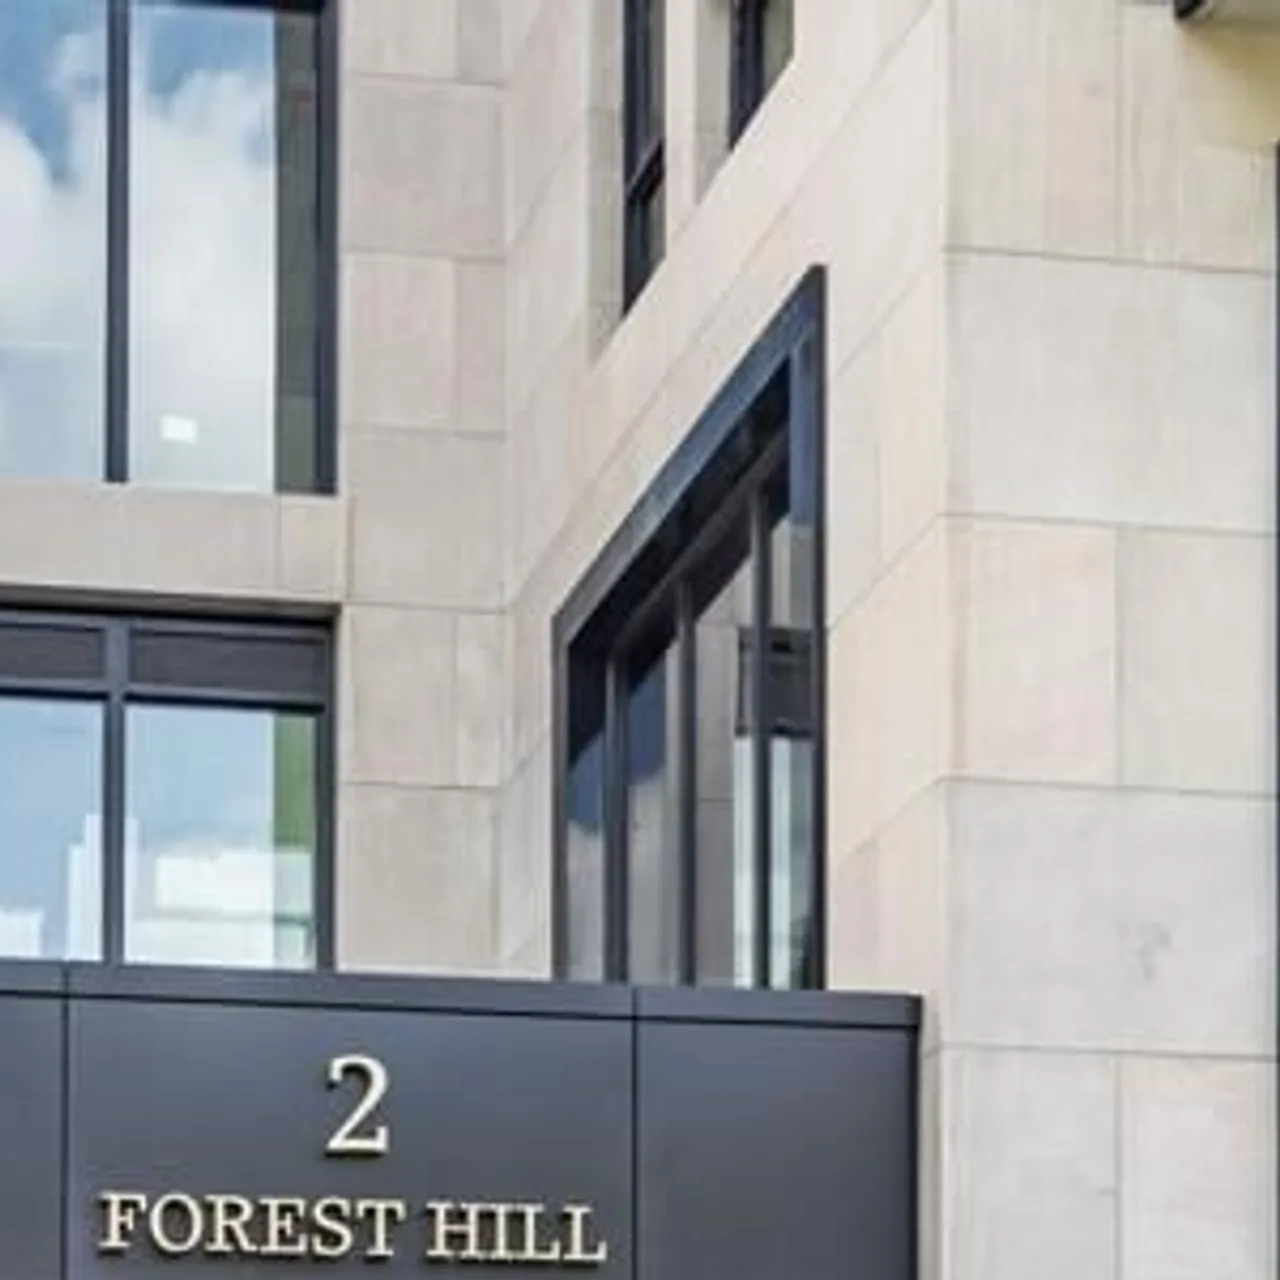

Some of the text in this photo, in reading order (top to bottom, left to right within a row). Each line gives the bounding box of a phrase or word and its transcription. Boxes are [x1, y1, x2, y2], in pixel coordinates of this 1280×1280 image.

[326, 1052, 389, 1154] 2
[97, 1190, 608, 1263] FOREST HILL
